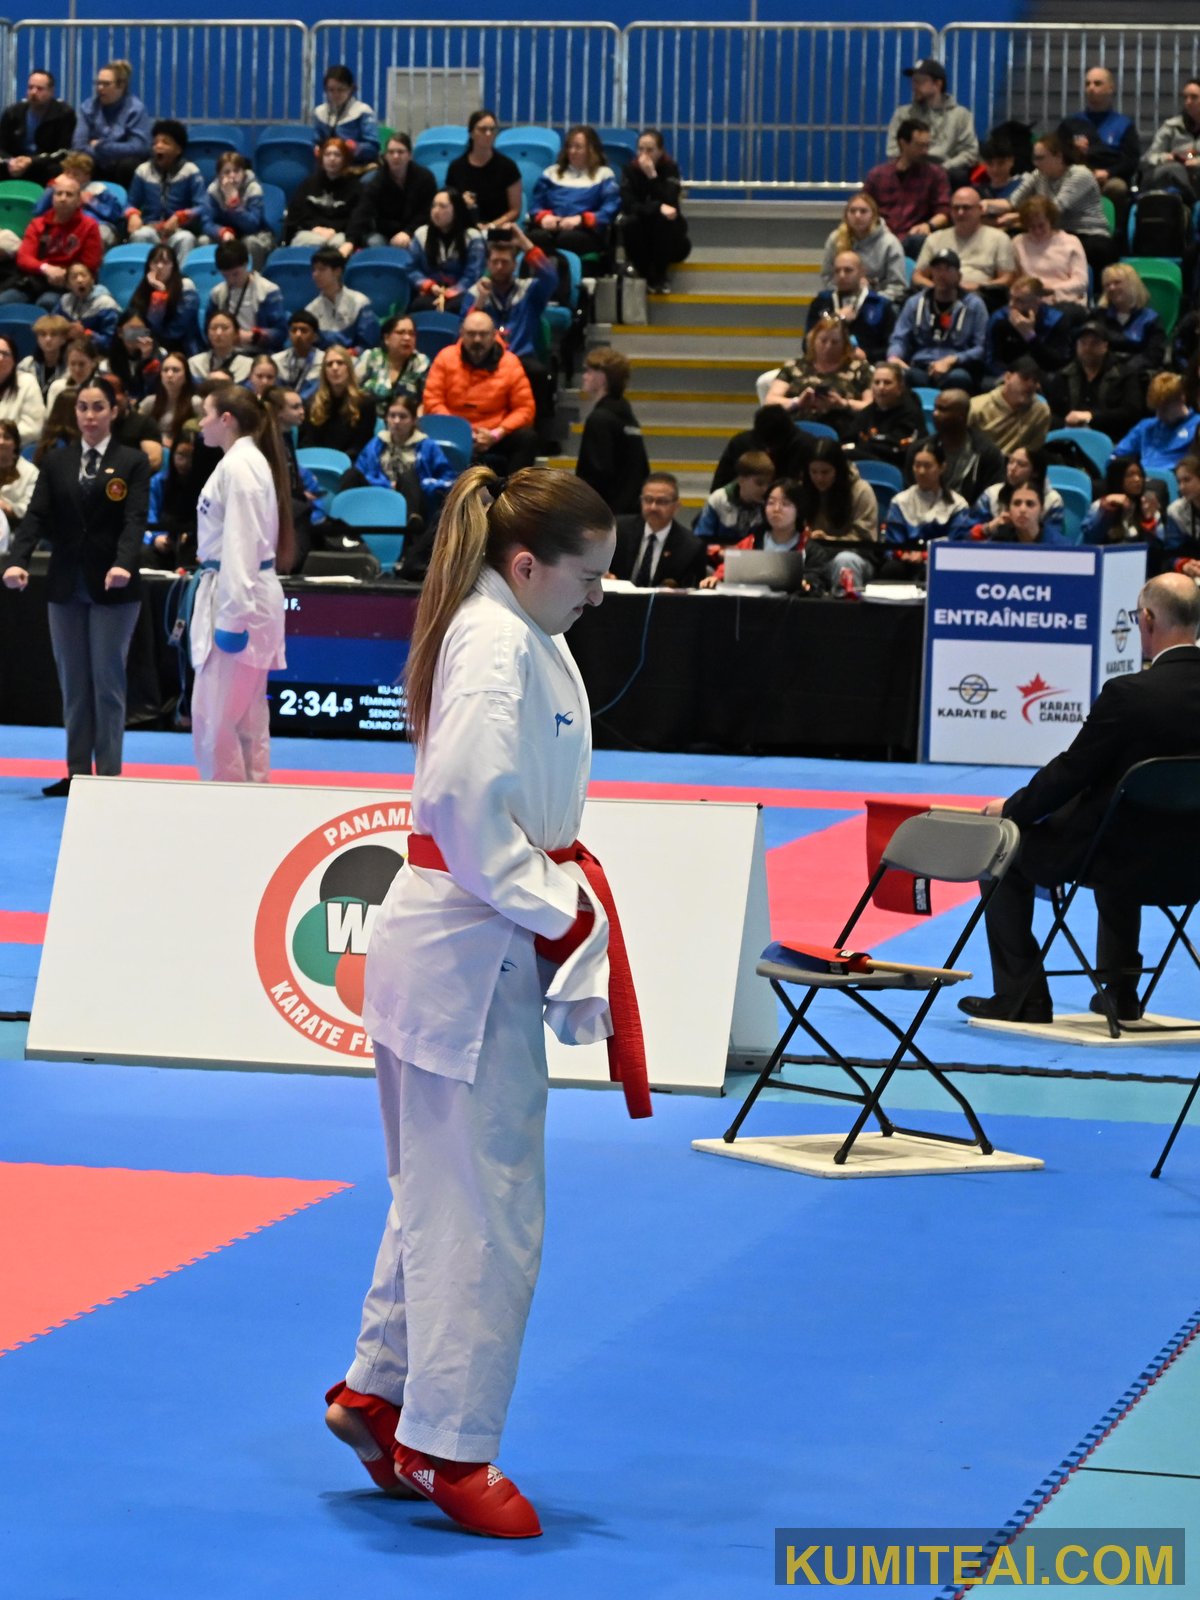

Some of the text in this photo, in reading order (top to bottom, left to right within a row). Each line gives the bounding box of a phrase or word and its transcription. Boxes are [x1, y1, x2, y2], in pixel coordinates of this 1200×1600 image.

[976, 583, 1051, 601] COACH
[279, 689, 353, 717] 2:34.5
[1039, 701, 1083, 713] KARATE
[937, 708, 1007, 720] KARATE BC
[1039, 712, 1084, 723] CANADA
[359, 719, 391, 731] ROUND
[270, 980, 344, 1047] KARATE
